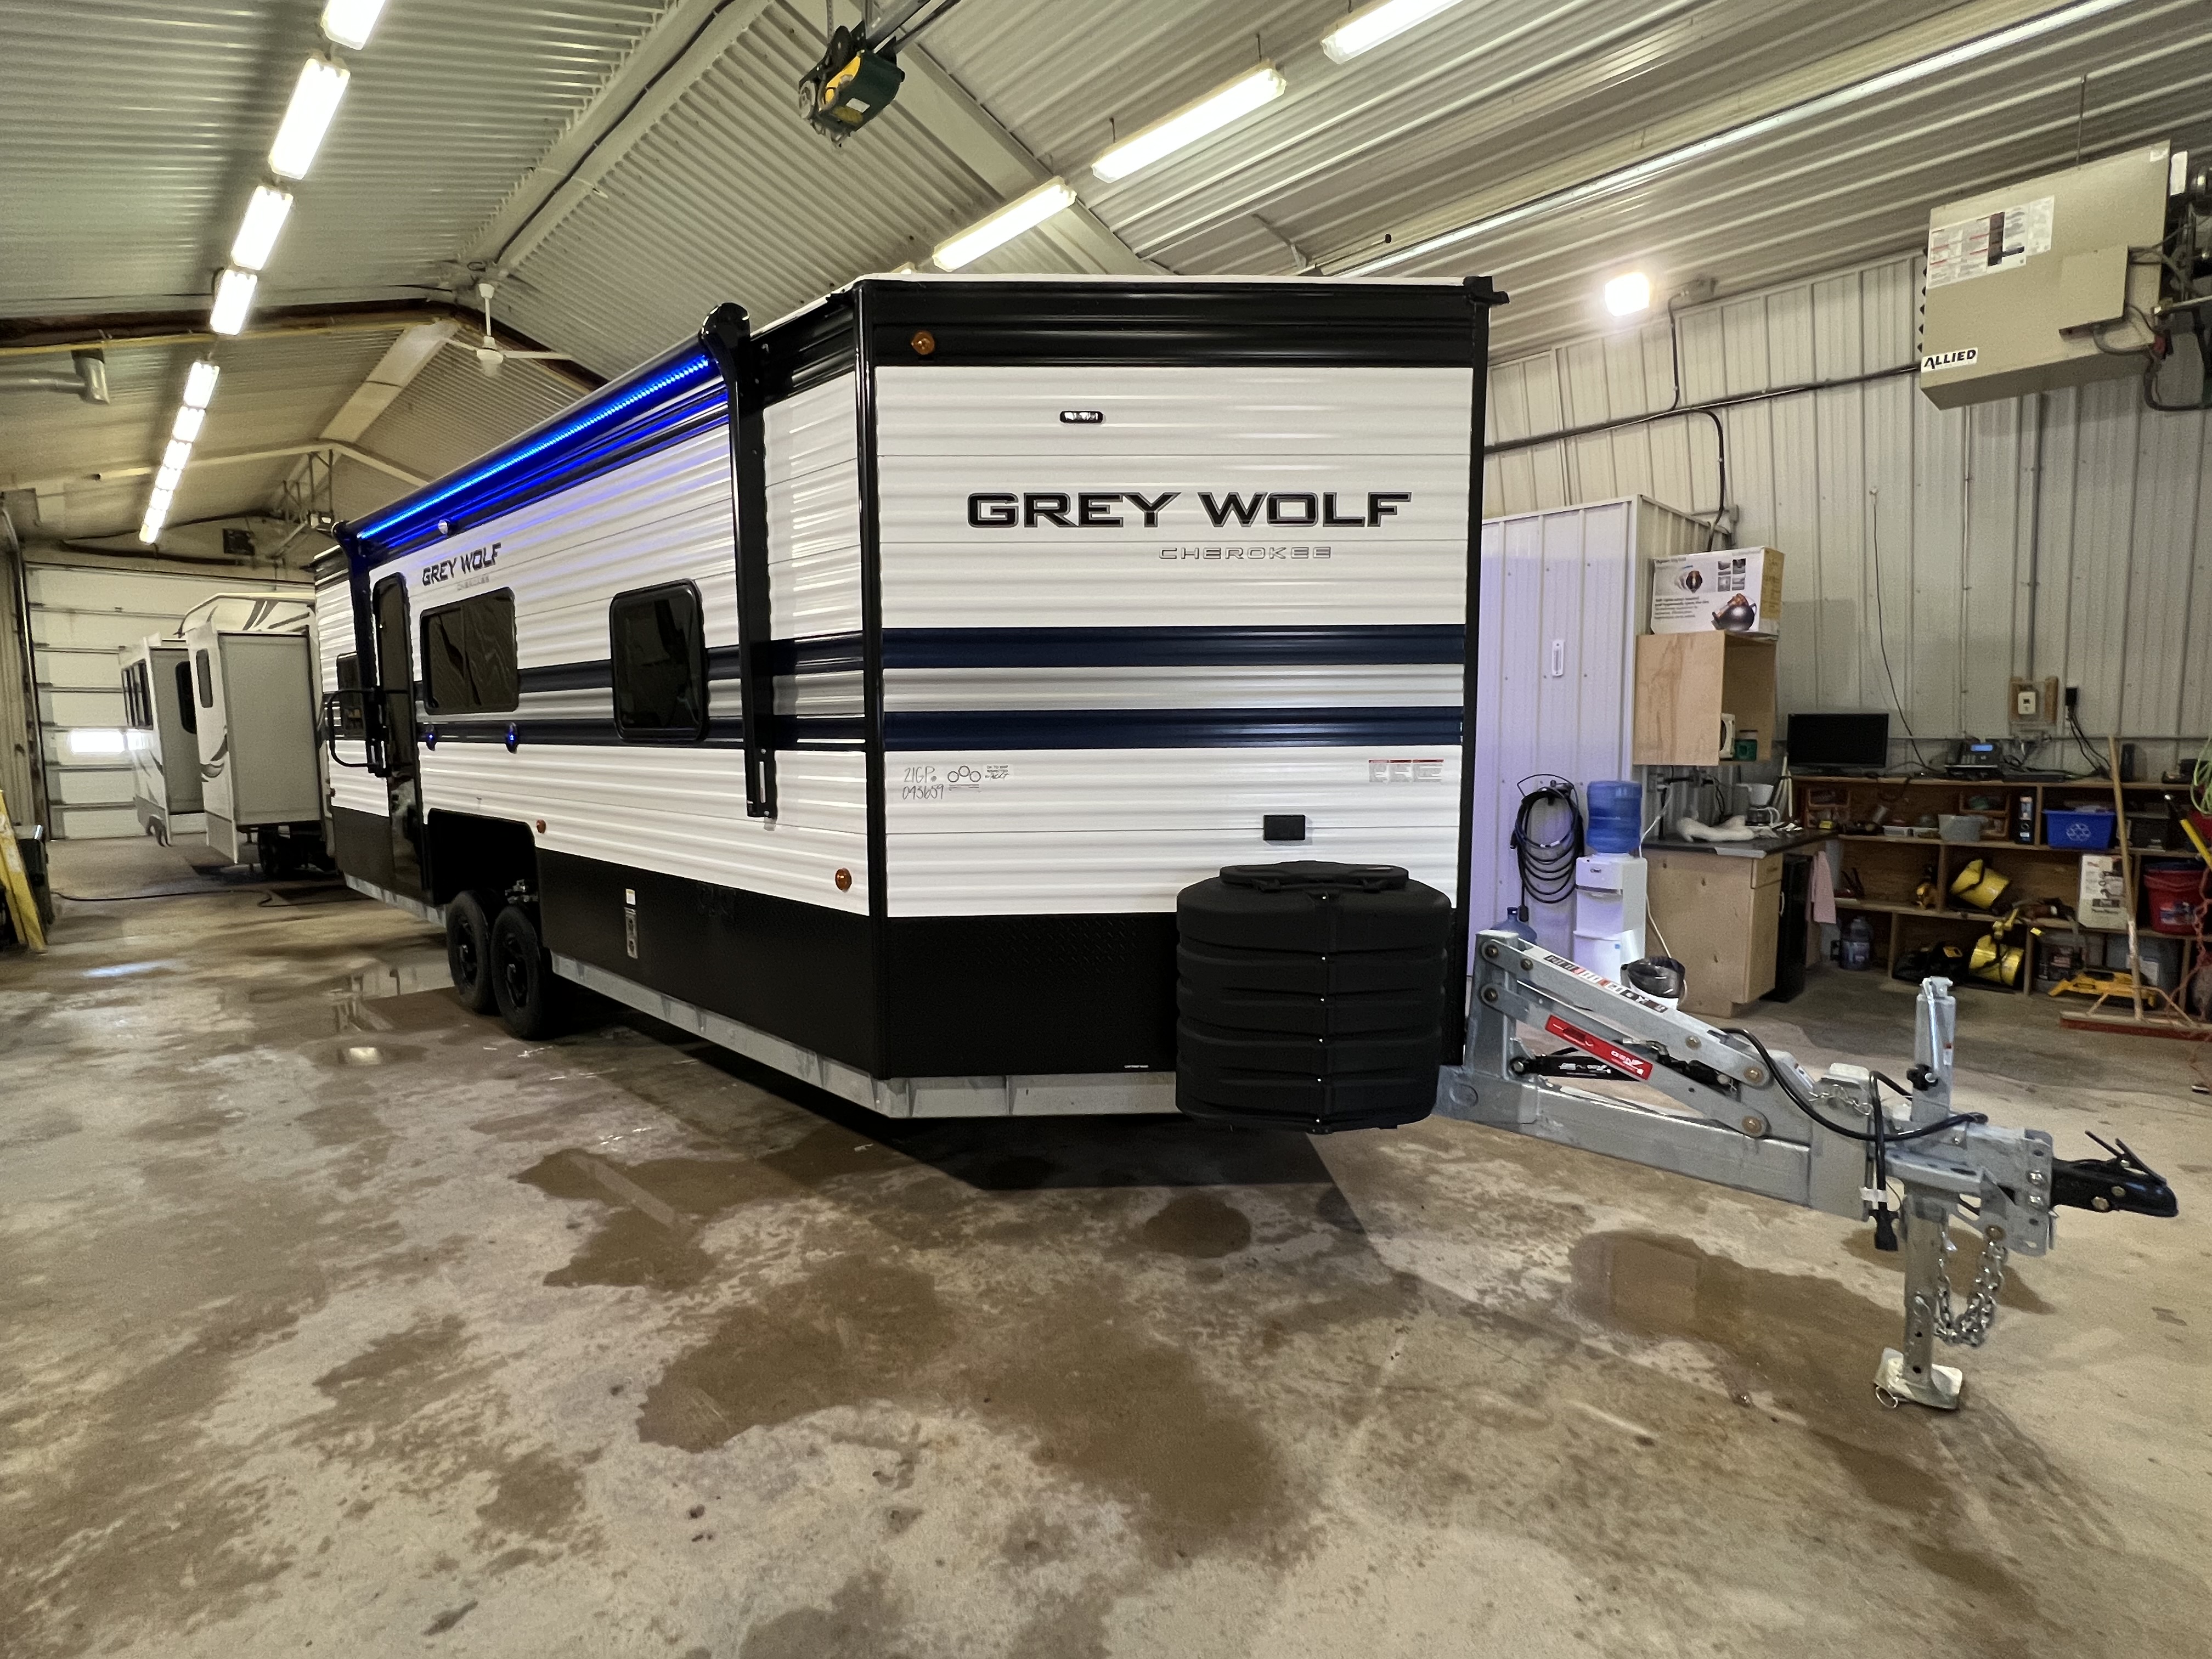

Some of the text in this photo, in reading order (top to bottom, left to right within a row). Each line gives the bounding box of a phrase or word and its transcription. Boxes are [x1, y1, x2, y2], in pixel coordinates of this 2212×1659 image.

[1924, 349, 1976, 369] ALLIED
[968, 492, 1412, 528] GREY WOLF
[422, 557, 457, 586] GREY
[460, 542, 501, 574] WOLF
[1159, 546, 1331, 560] CHEROKEE
